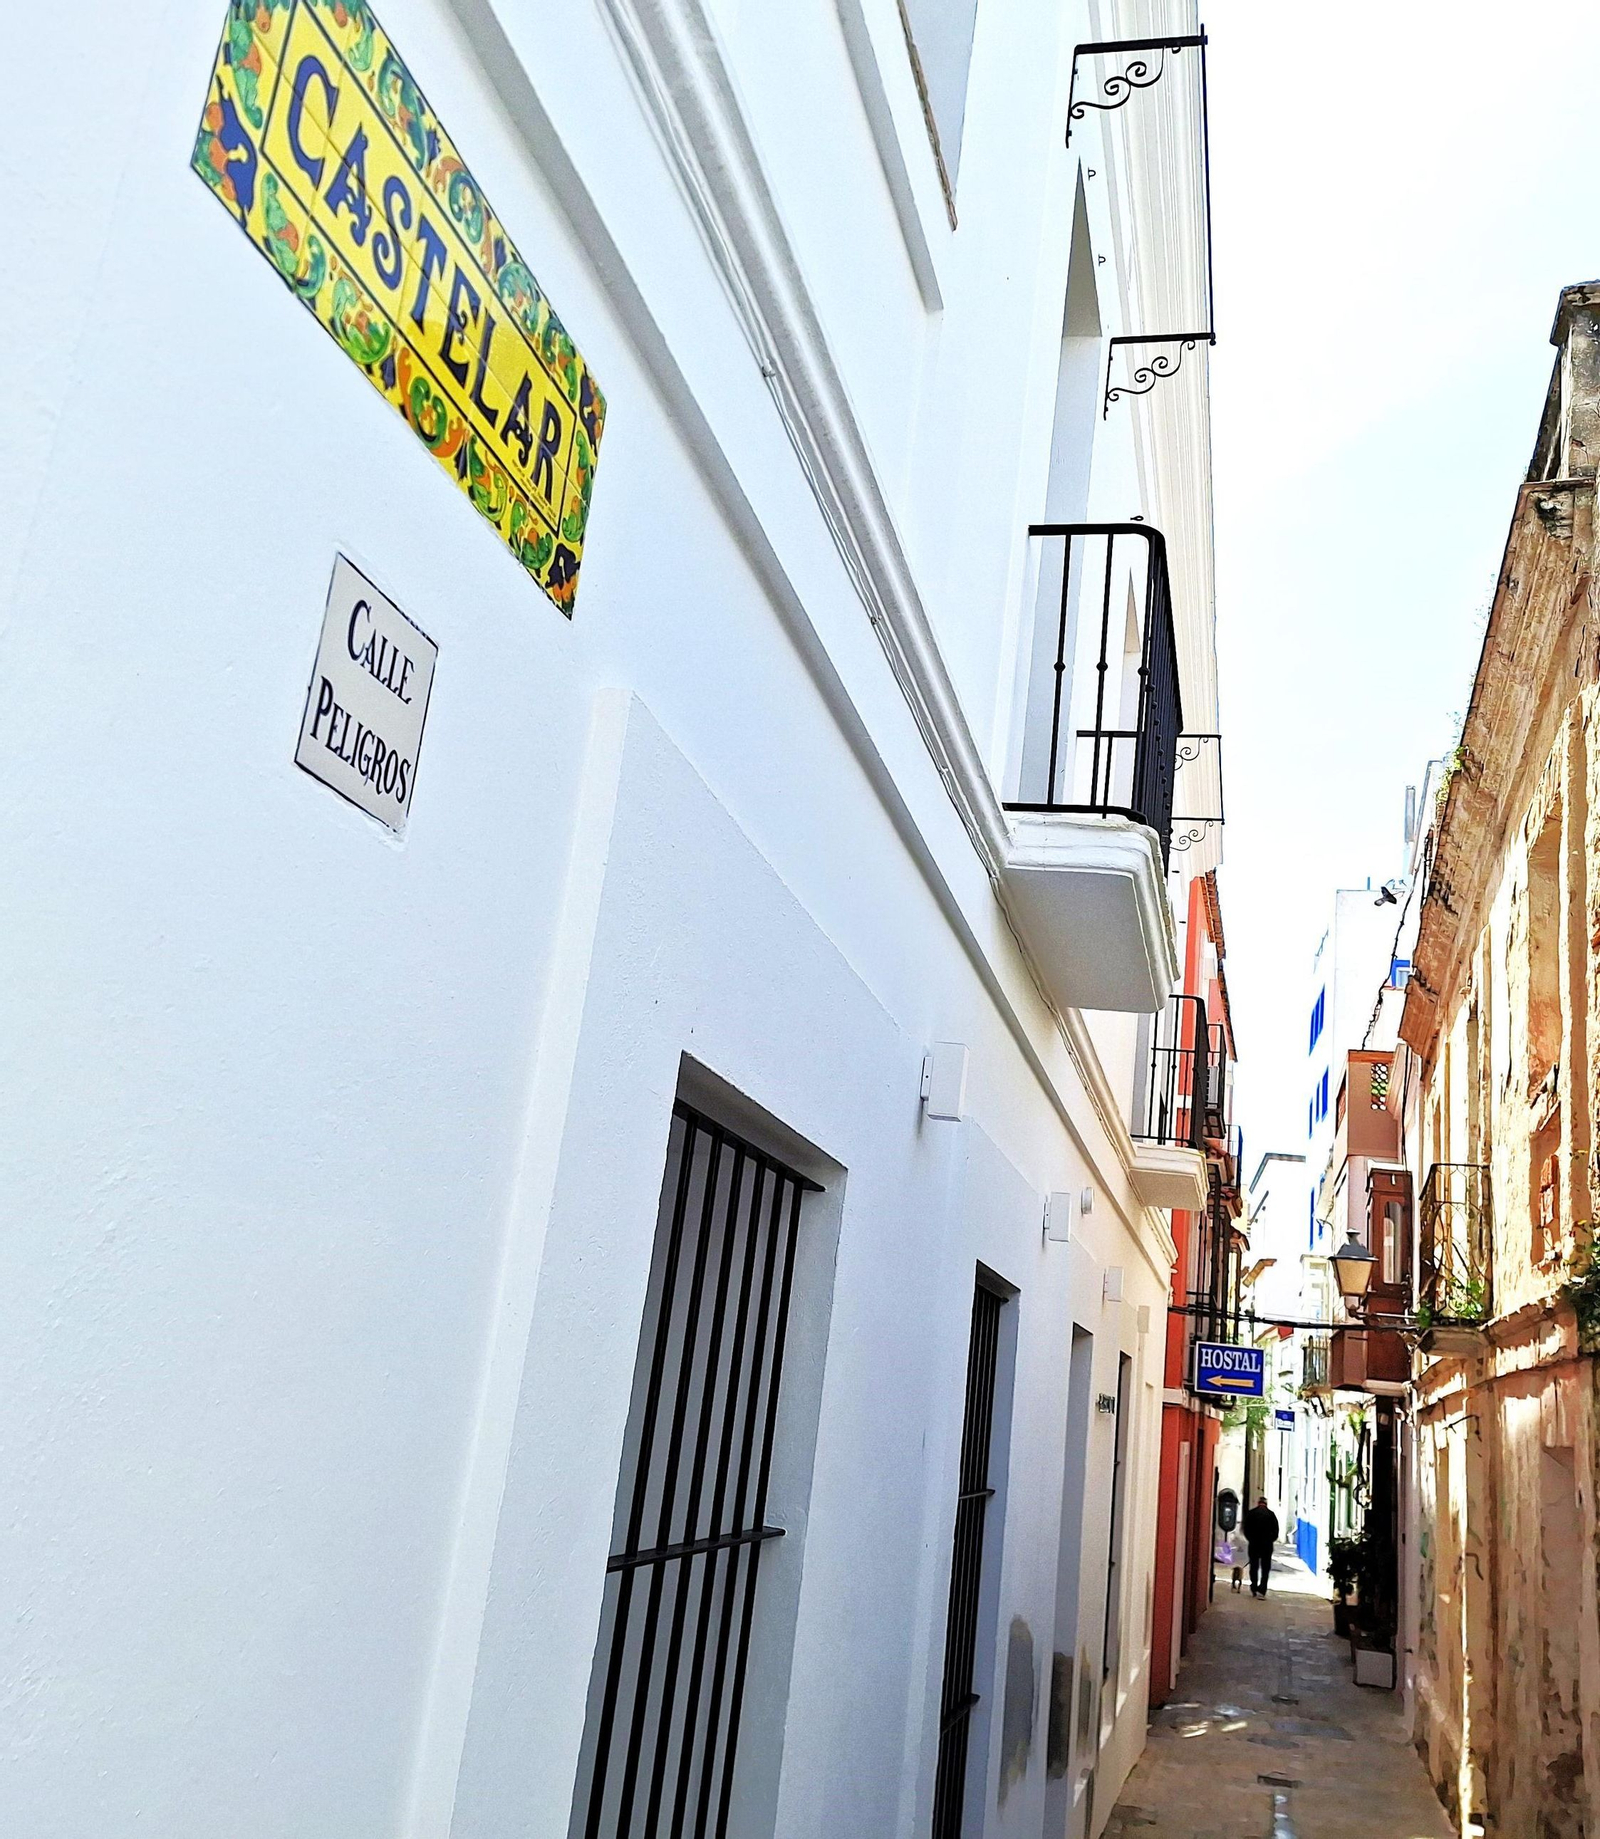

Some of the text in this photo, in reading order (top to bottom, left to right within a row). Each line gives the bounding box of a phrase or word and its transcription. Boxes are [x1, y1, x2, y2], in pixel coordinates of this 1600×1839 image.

[287, 55, 561, 500] CASTELAR
[348, 600, 414, 704] CALLE
[310, 675, 411, 804] PELIGROS
[1200, 1348, 1260, 1372] HOSTAL
